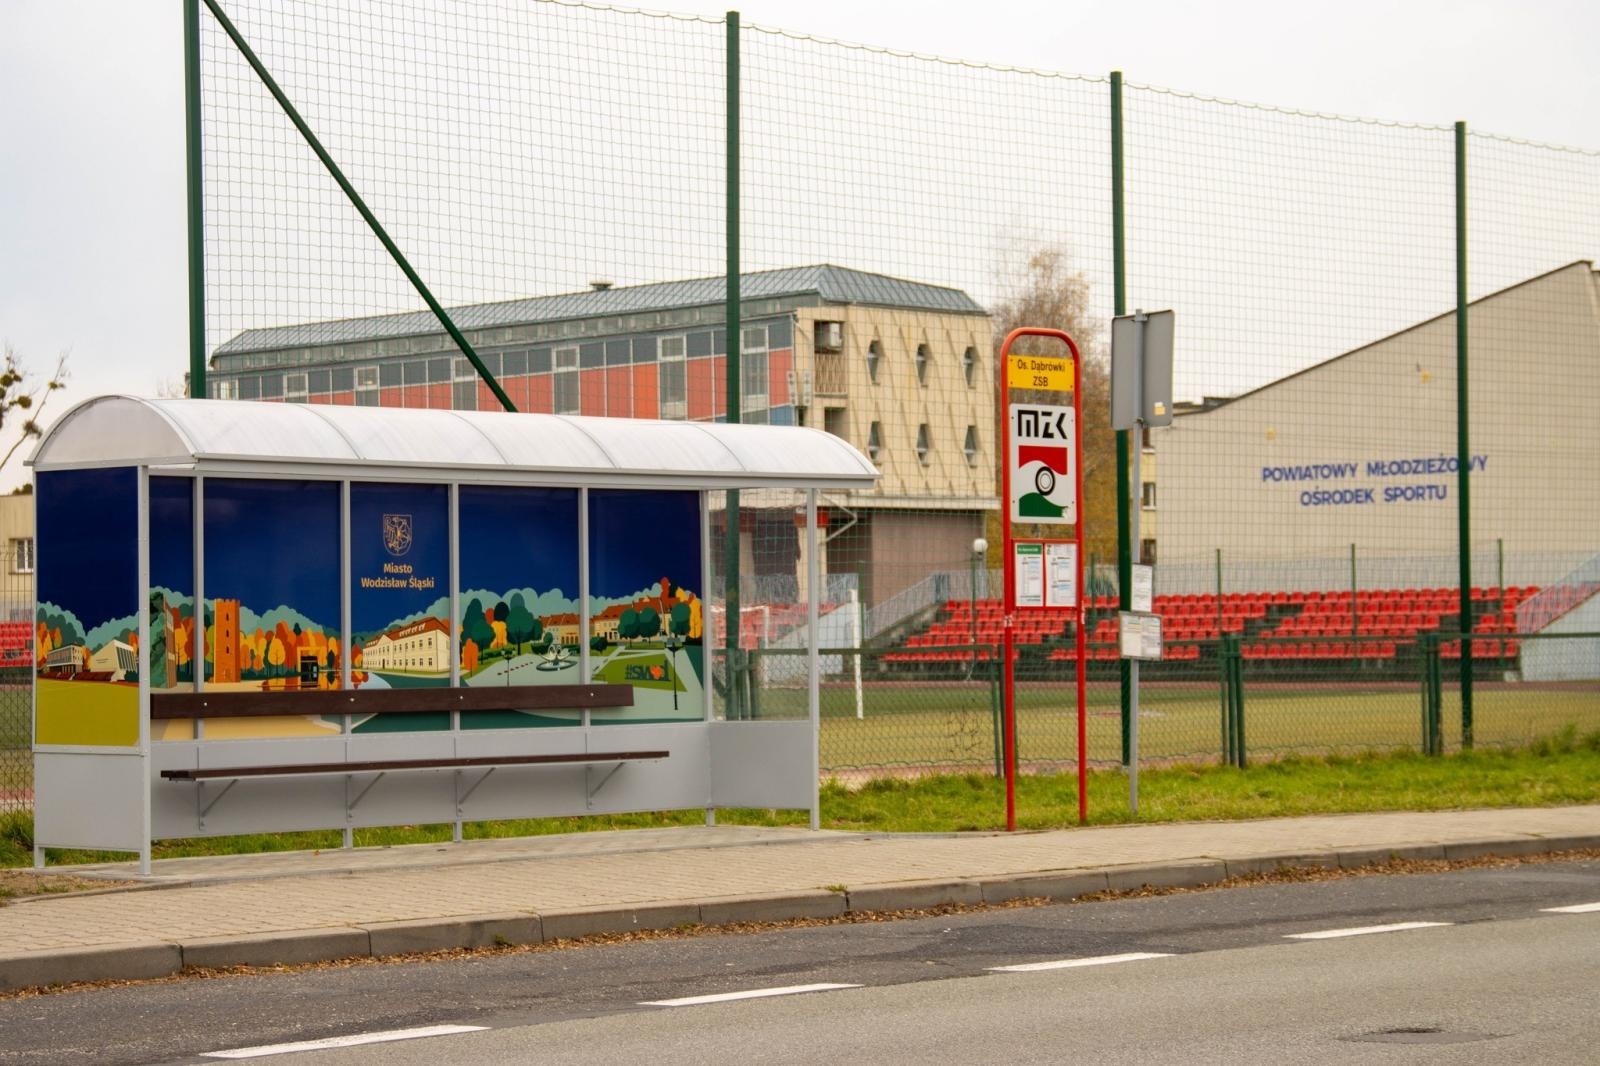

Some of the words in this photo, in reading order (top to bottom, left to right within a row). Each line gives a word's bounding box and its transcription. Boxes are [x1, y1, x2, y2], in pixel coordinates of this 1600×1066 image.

[1017, 359, 1028, 370] Os.
[1033, 375, 1049, 387] ZSB
[1017, 409, 1068, 440] MZK
[1262, 462, 1358, 482] POWIATOWY
[1300, 485, 1375, 507] OŚRODEK
[1384, 484, 1448, 502] SPORTU
[383, 563, 413, 574] Miasto
[361, 577, 407, 588] Wodzisław
[409, 575, 435, 591] Śląski
